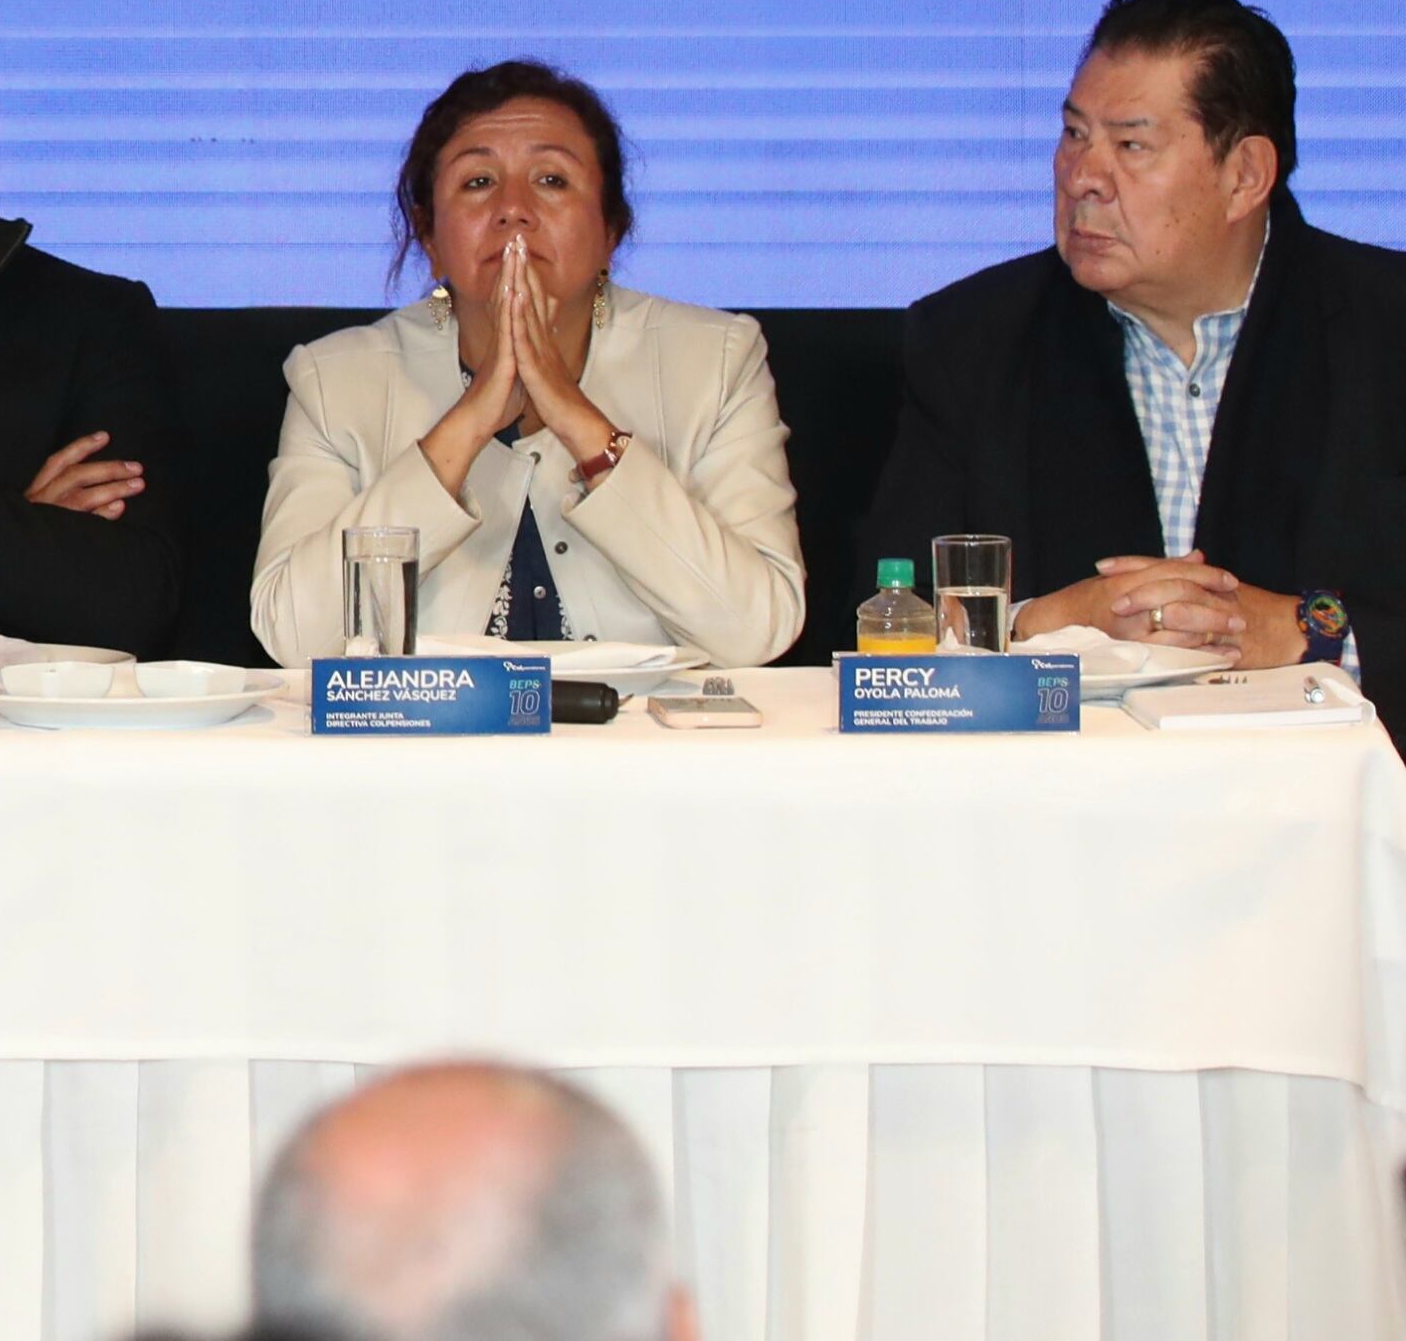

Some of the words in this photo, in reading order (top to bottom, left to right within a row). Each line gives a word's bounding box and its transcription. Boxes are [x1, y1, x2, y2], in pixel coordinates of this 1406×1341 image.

[327, 670, 474, 688] ALEJANDRA
[855, 668, 935, 686] PERCY
[326, 688, 389, 702] SÁNCHEZ
[393, 689, 457, 703] VÁSQUEZ
[854, 687, 900, 699] OYOLA
[904, 685, 961, 699] PALOMÁ
[509, 690, 541, 715] 10
[1037, 687, 1068, 713] 10
[326, 712, 377, 720] INTEGRANTE
[378, 712, 404, 720] JUNTA
[853, 710, 904, 718] PRESIDENTE
[326, 719, 369, 727] DIRECTIVA
[370, 719, 431, 728] COLPENSIONES
[853, 717, 892, 726] GENERAL
[893, 717, 909, 726] DEL
[910, 717, 948, 726] TRABAJO
